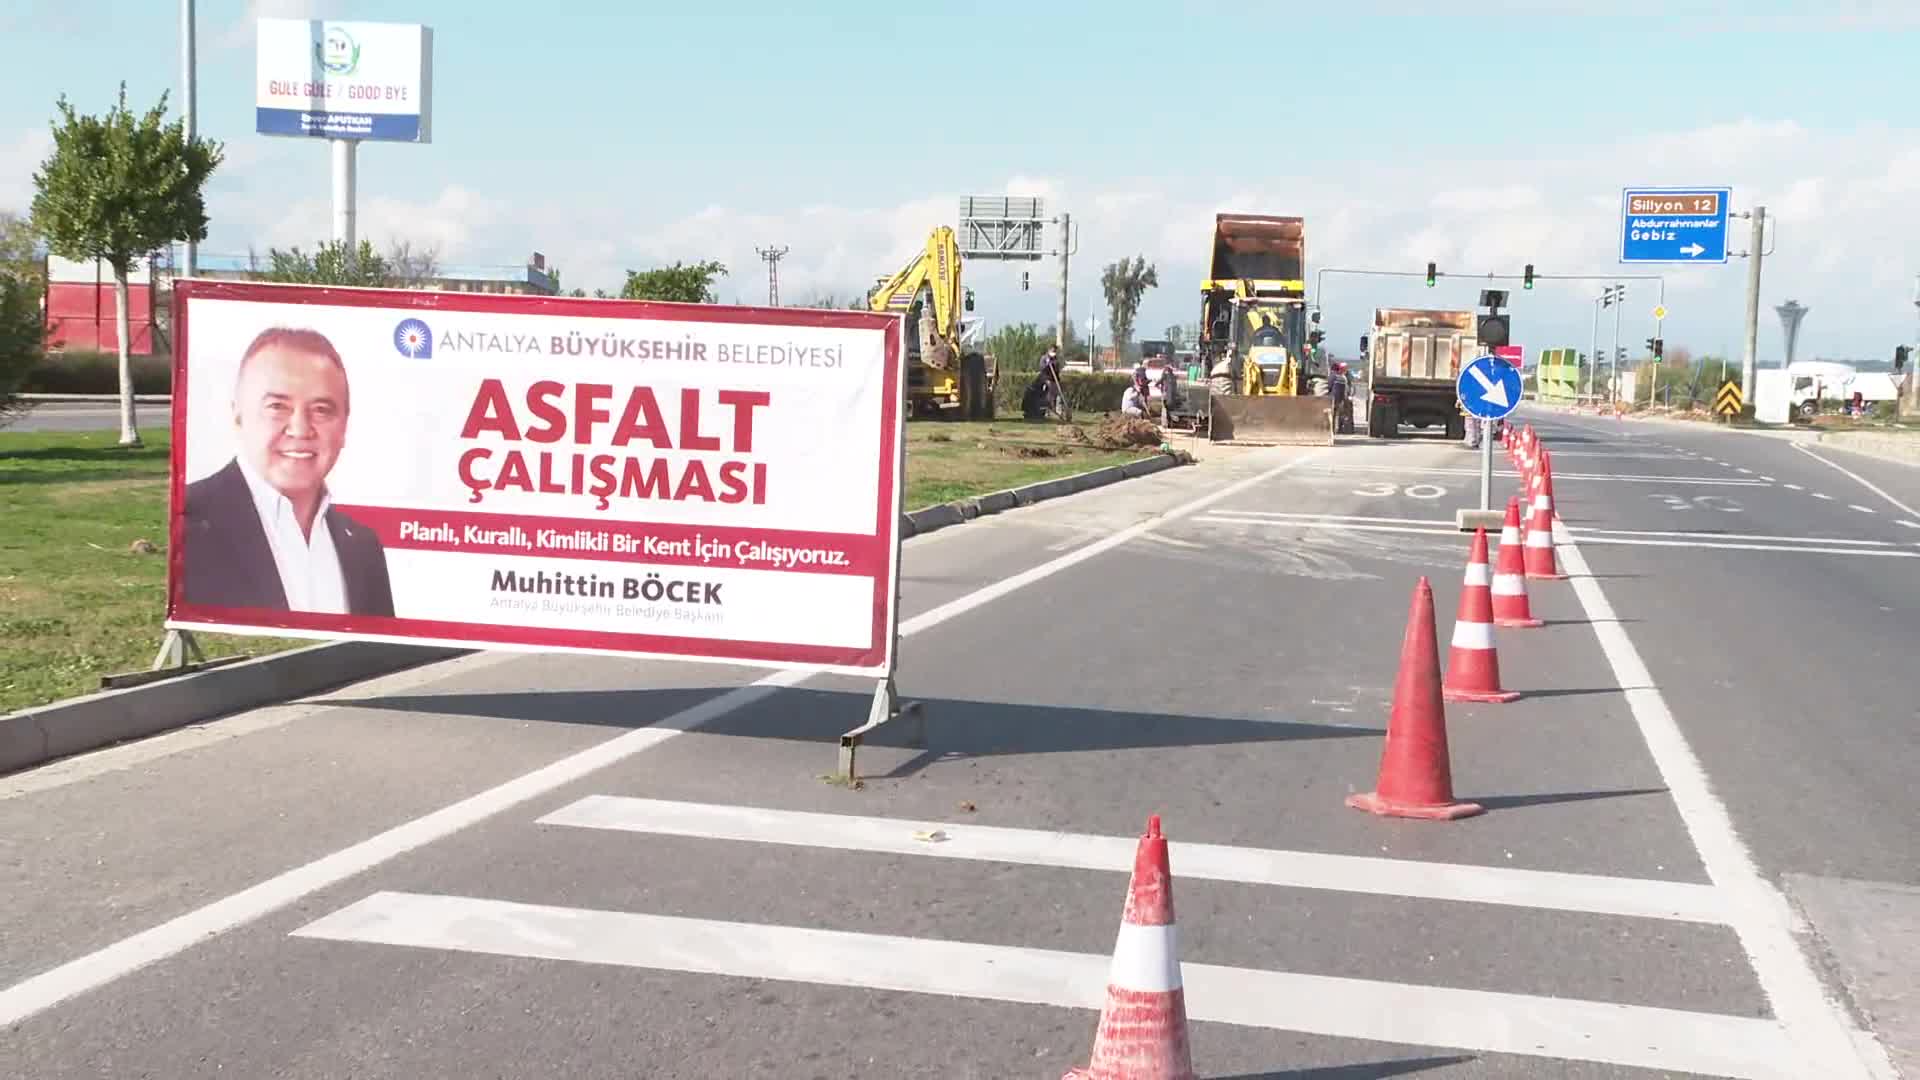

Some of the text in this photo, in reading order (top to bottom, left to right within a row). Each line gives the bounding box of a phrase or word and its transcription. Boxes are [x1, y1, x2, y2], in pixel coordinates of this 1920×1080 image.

[348, 85, 381, 100] GOOD
[385, 87, 408, 100] BYE
[1632, 199, 1712, 213] Sillyon 12
[1631, 218, 1719, 229] Abdurrahmanlar
[1631, 229, 1676, 241] Gebiz
[439, 329, 844, 368] ANTALYA BÜYÜKŞEHİR BELEDİYESİ
[460, 378, 771, 453] ASFALT
[458, 447, 767, 511] ÇALIŞMASI
[1352, 482, 1448, 498] 30
[399, 521, 850, 568] Planlı, Kurallı, Kimlikli Bir Kent İçin Çalışıyoruz.
[491, 569, 723, 605] Muhittin BÖCEK
